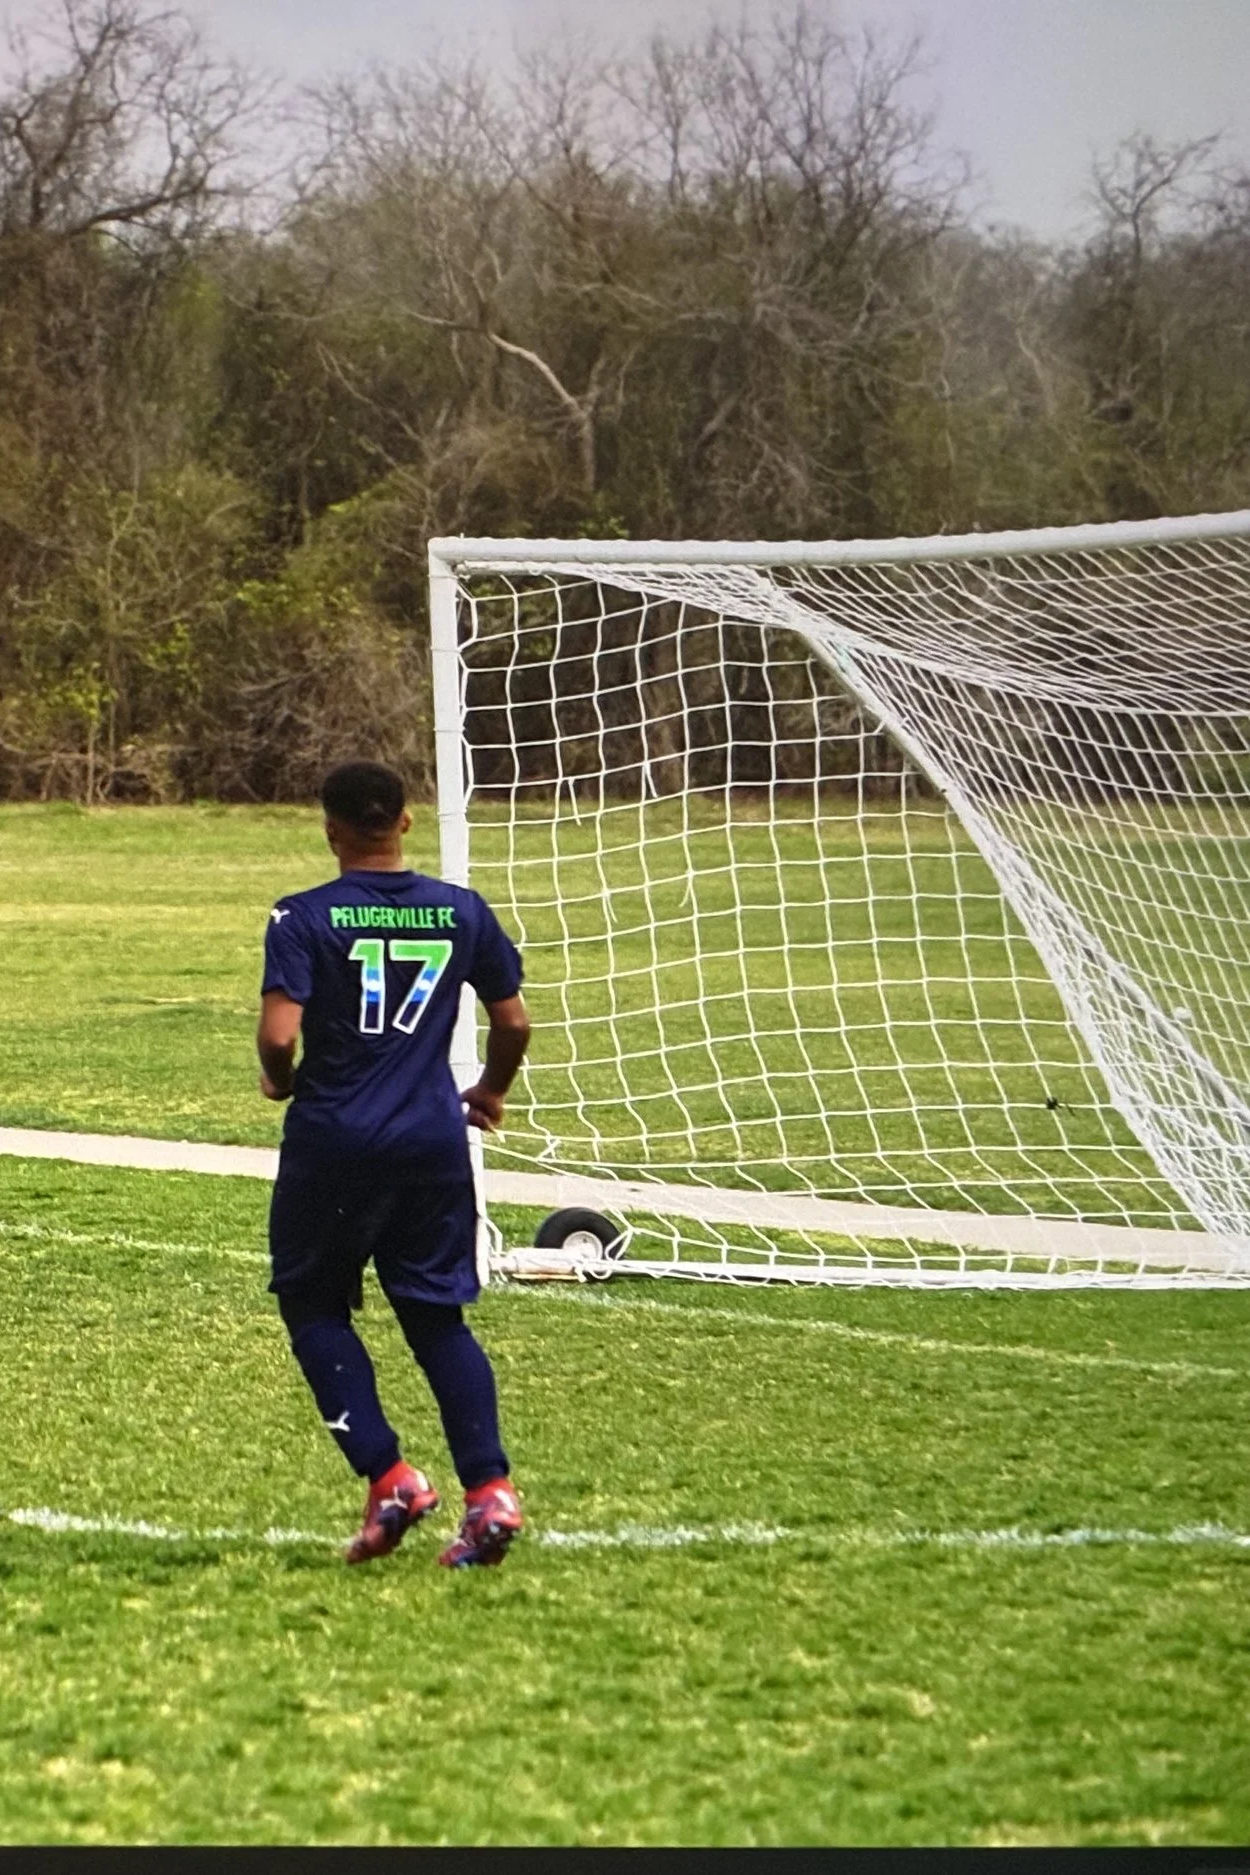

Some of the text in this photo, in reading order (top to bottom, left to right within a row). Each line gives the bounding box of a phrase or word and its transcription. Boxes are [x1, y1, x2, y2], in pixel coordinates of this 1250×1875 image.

[330, 906, 457, 929] PFLUGERVILLE FC
[348, 938, 453, 1034] 17
